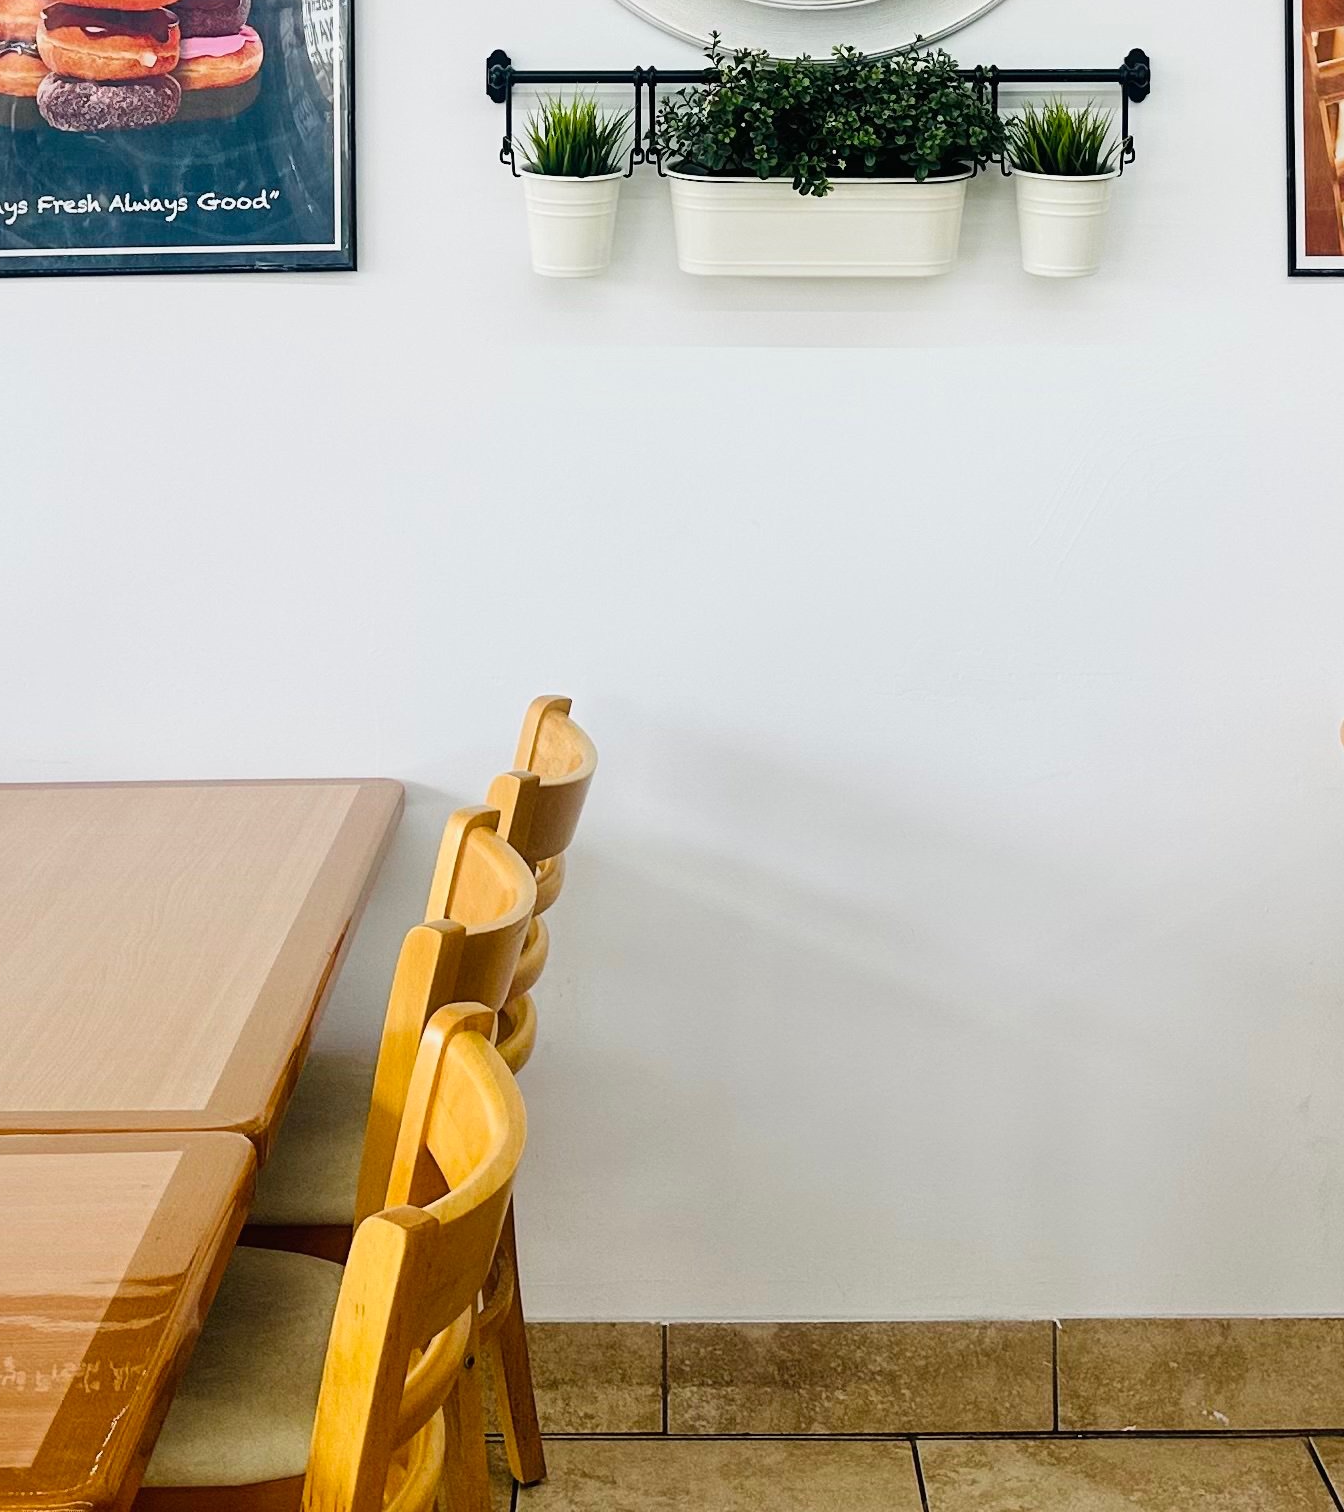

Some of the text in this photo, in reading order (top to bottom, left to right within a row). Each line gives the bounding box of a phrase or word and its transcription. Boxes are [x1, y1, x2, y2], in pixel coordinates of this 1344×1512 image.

[37, 194, 101, 215] Fresh
[109, 190, 188, 223] Always
[196, 190, 280, 212] Good"
